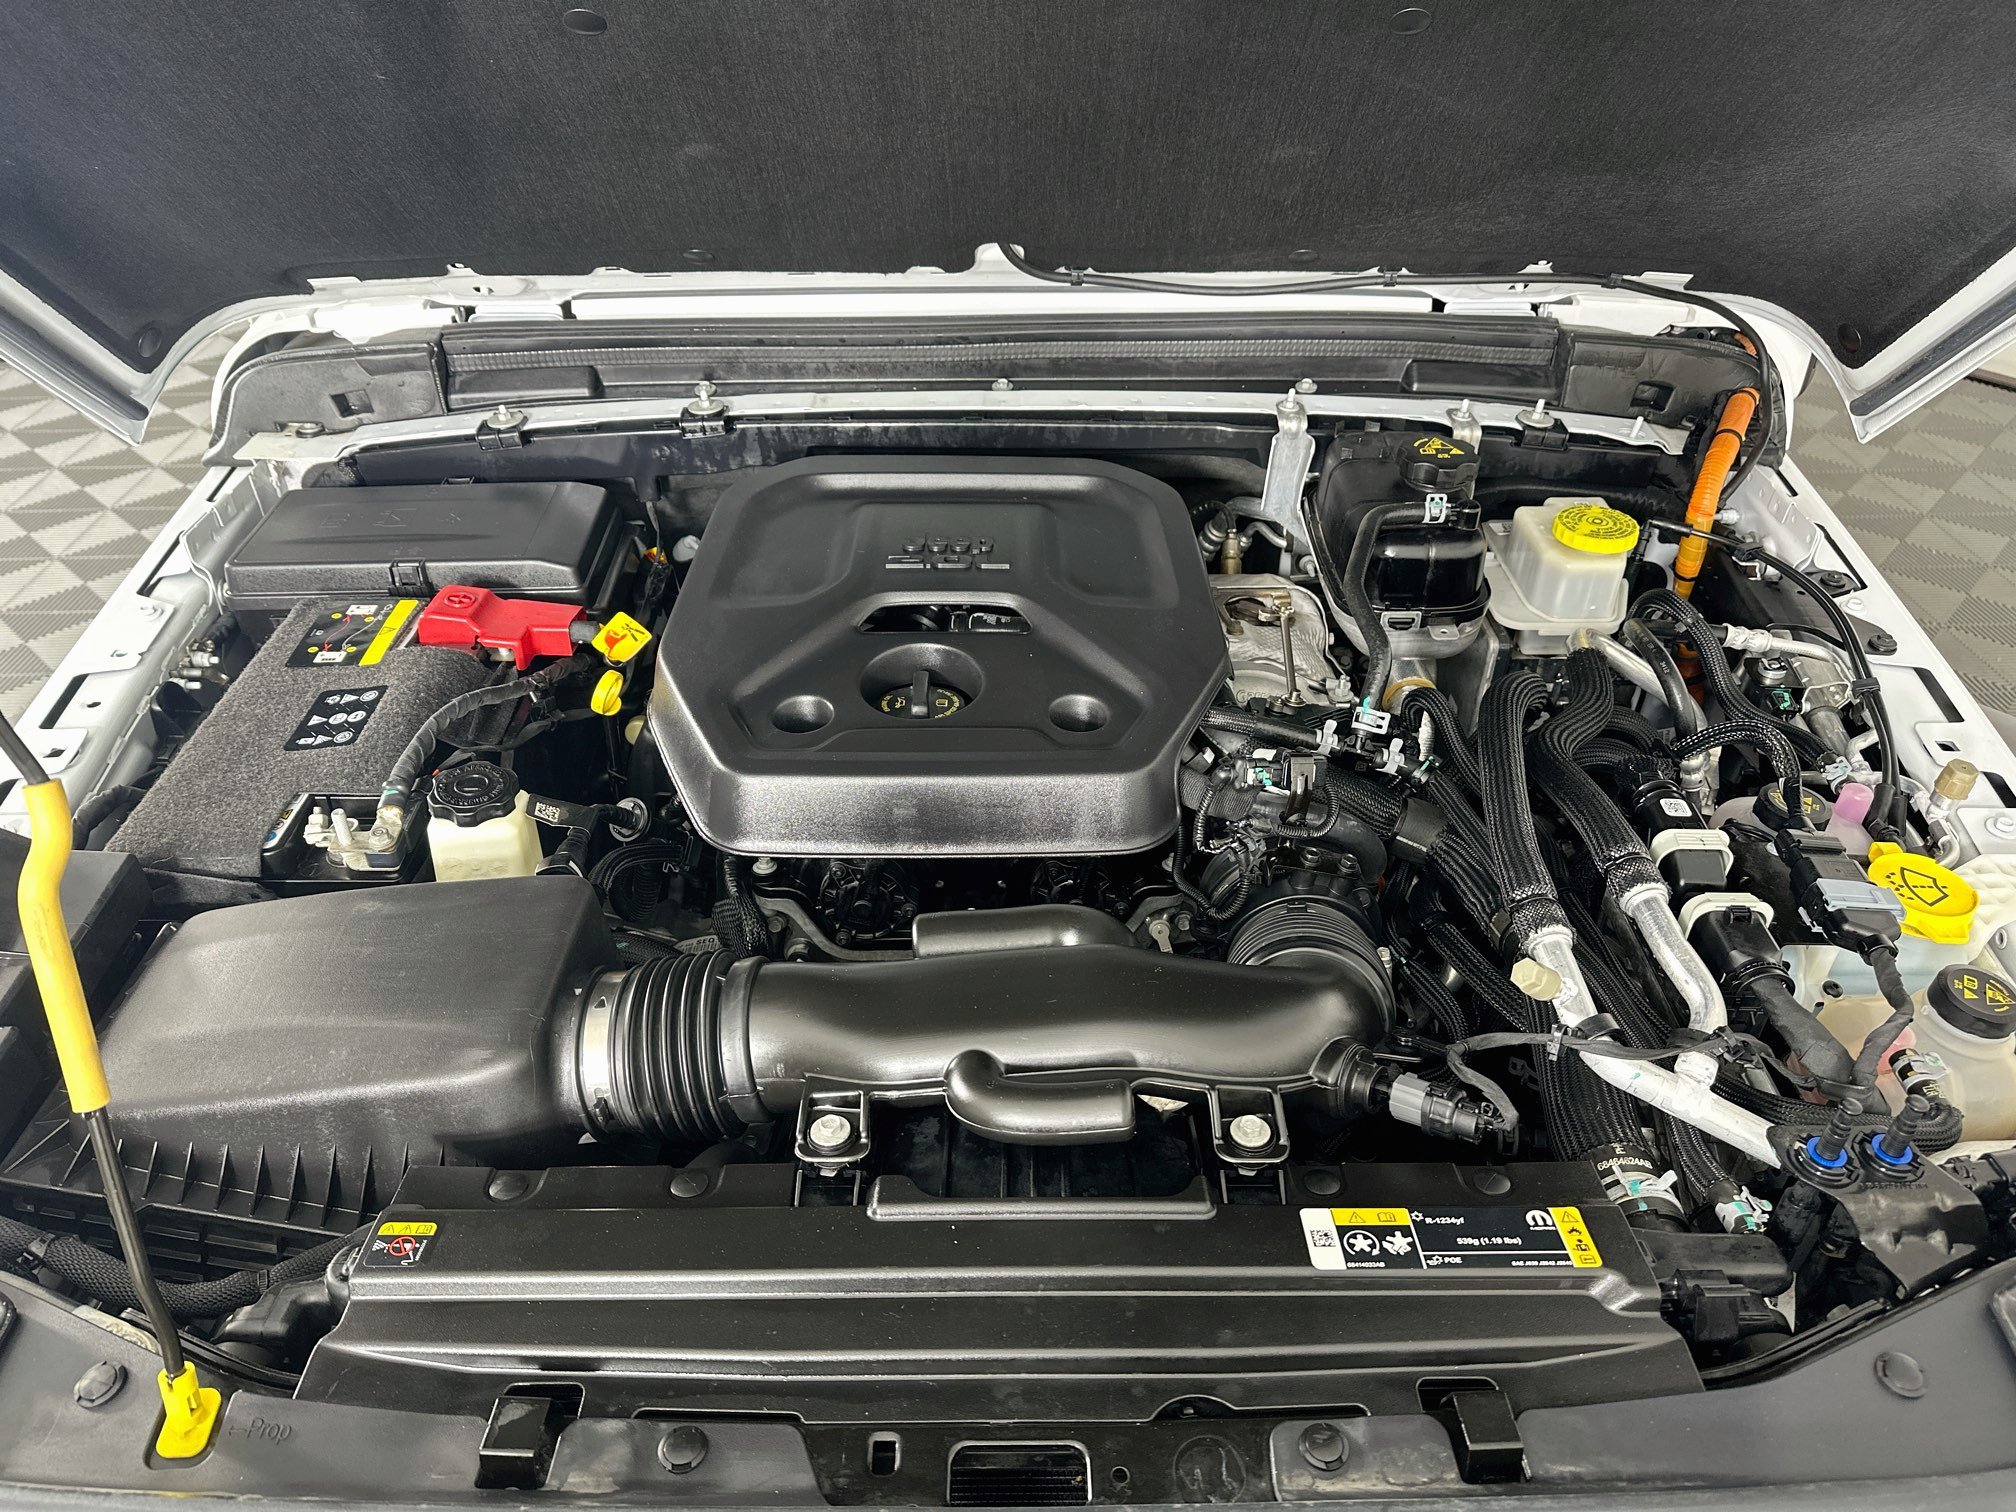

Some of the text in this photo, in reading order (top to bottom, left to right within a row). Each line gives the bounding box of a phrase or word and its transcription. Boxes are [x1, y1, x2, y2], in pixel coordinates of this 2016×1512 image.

[1456, 1237, 1480, 1246] 539g
[1443, 1256, 1463, 1264] POE
[248, 1417, 292, 1446] Prop
